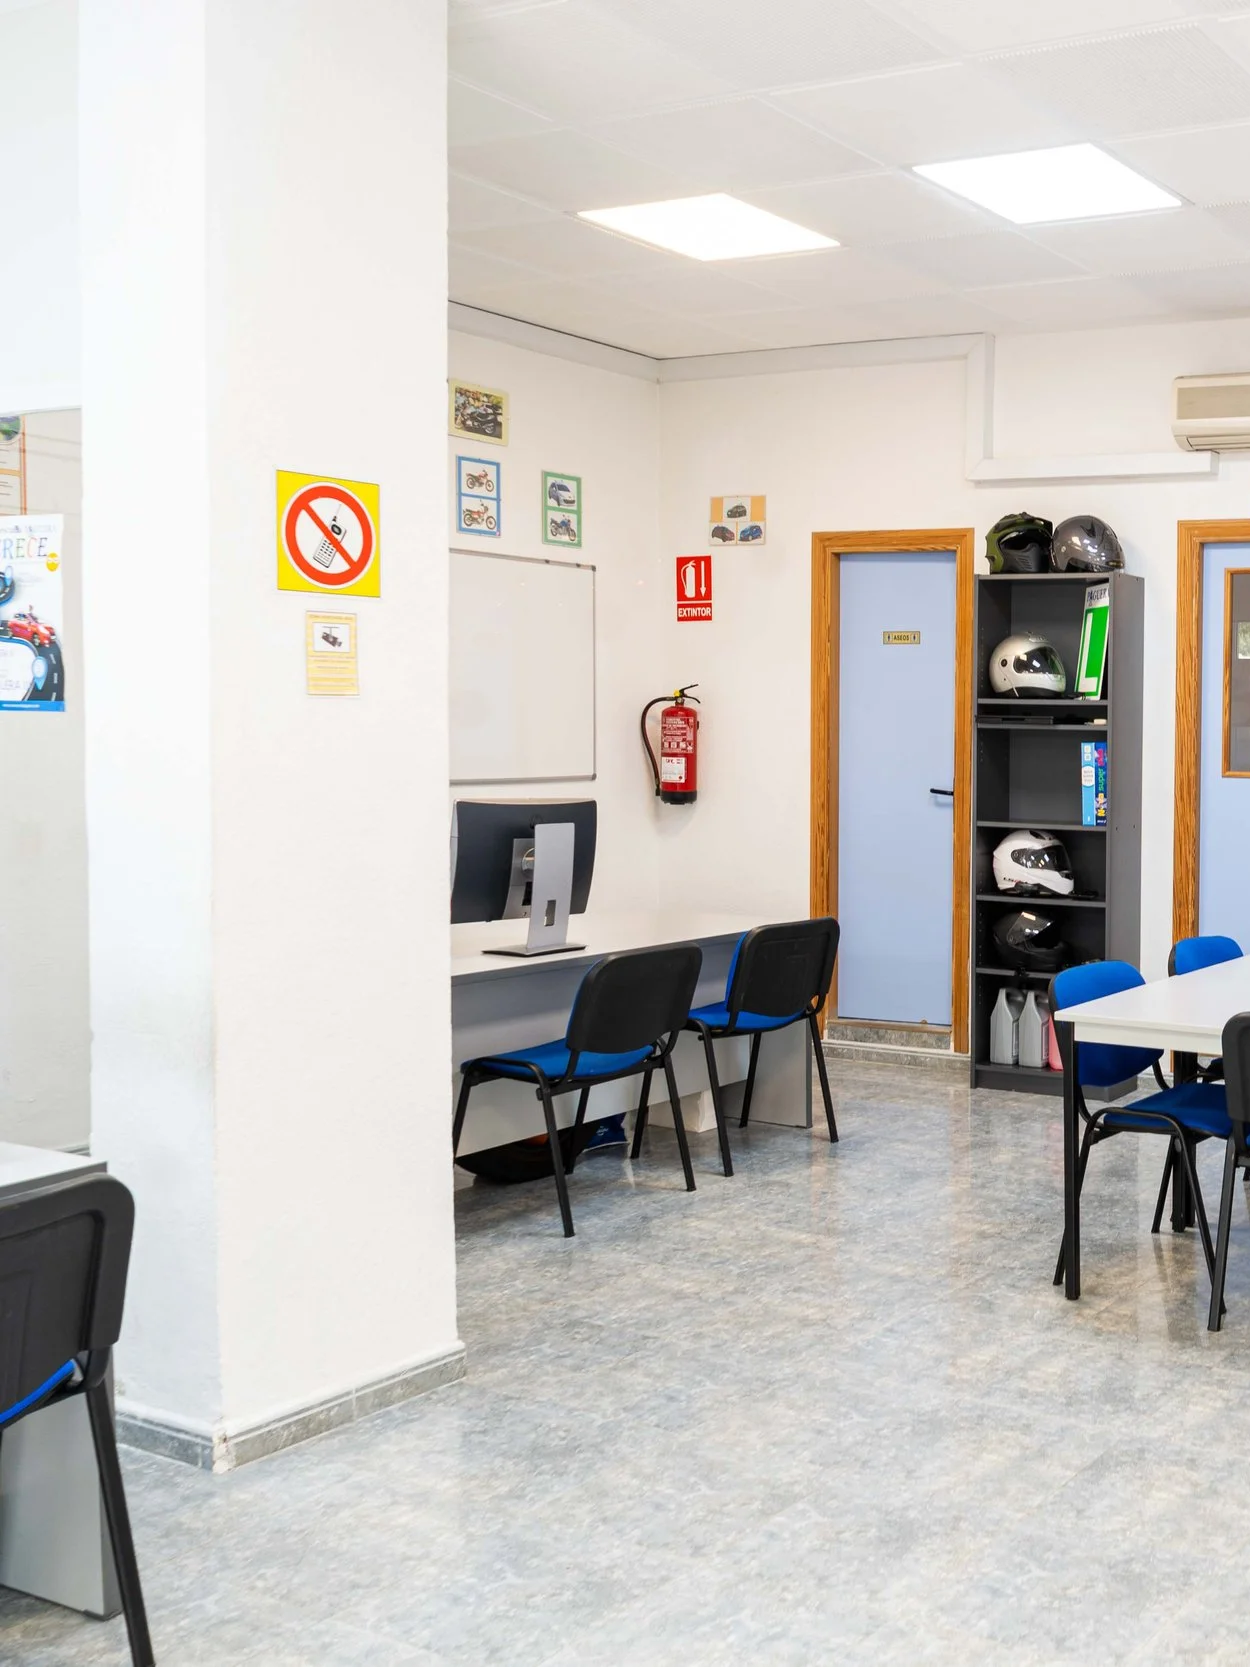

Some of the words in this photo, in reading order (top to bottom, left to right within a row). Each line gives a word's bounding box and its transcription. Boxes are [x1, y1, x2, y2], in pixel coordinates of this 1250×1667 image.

[0, 537, 48, 559] RECE
[678, 607, 711, 617] EXTINTOR
[1078, 613, 1098, 692] L
